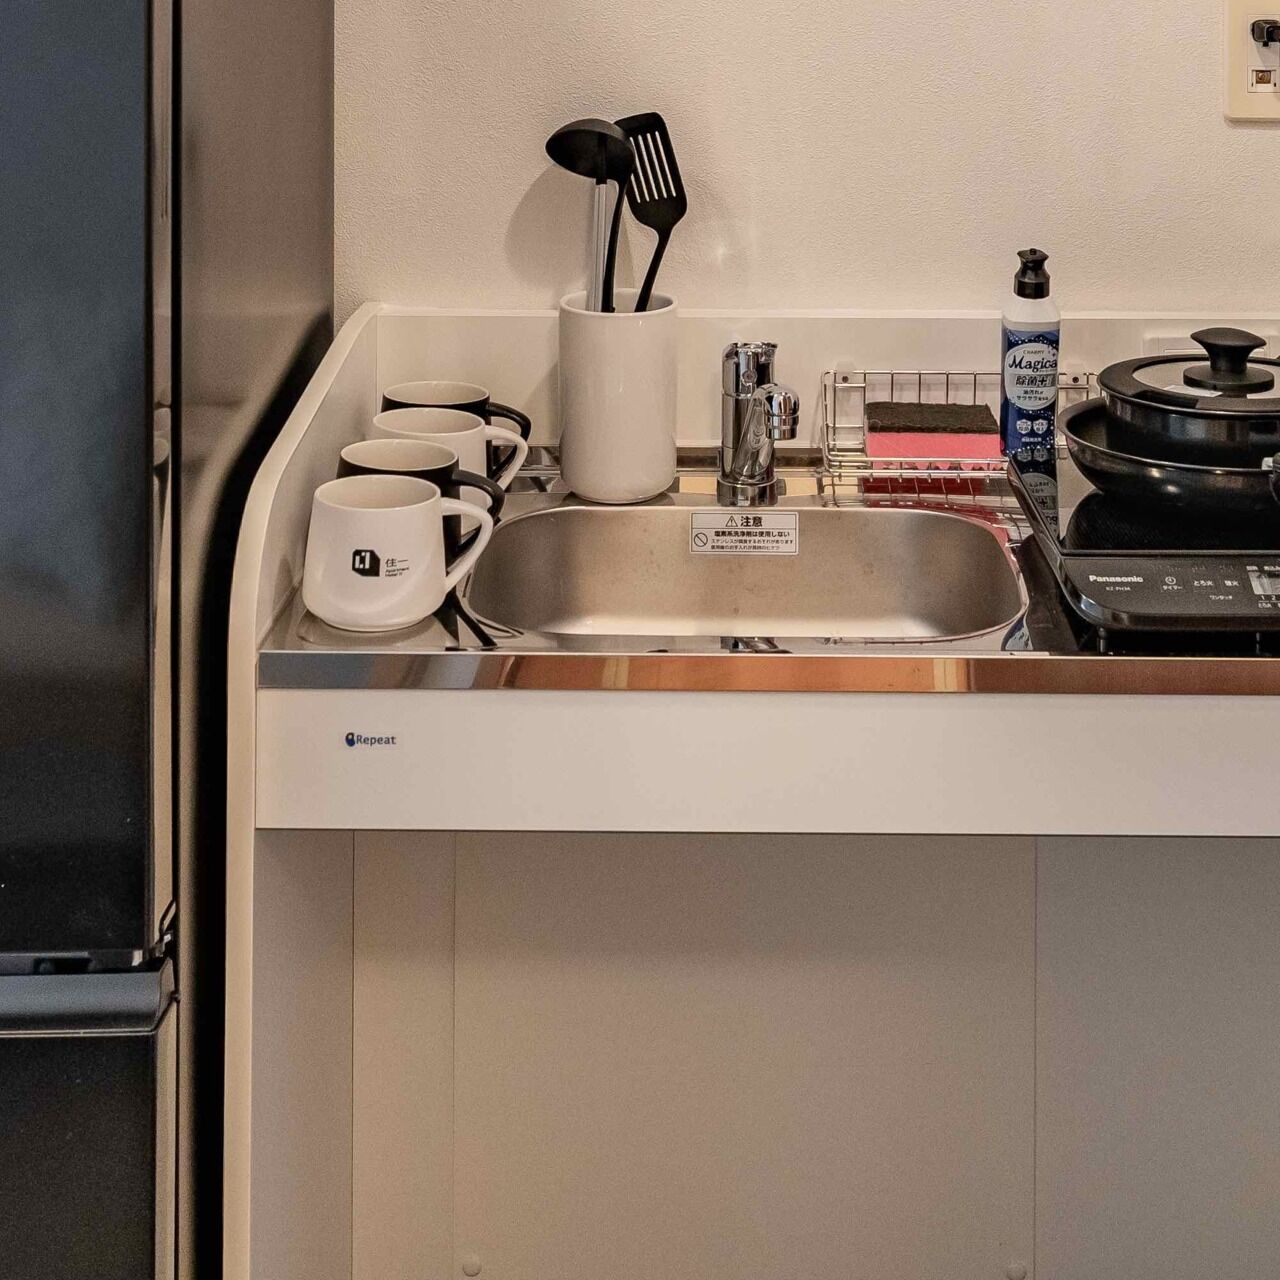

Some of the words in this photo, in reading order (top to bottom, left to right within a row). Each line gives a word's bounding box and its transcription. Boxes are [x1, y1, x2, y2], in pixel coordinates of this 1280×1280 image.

[1009, 354, 1057, 373] Magica
[740, 516, 763, 527] 注意
[356, 734, 396, 745] Repeat
